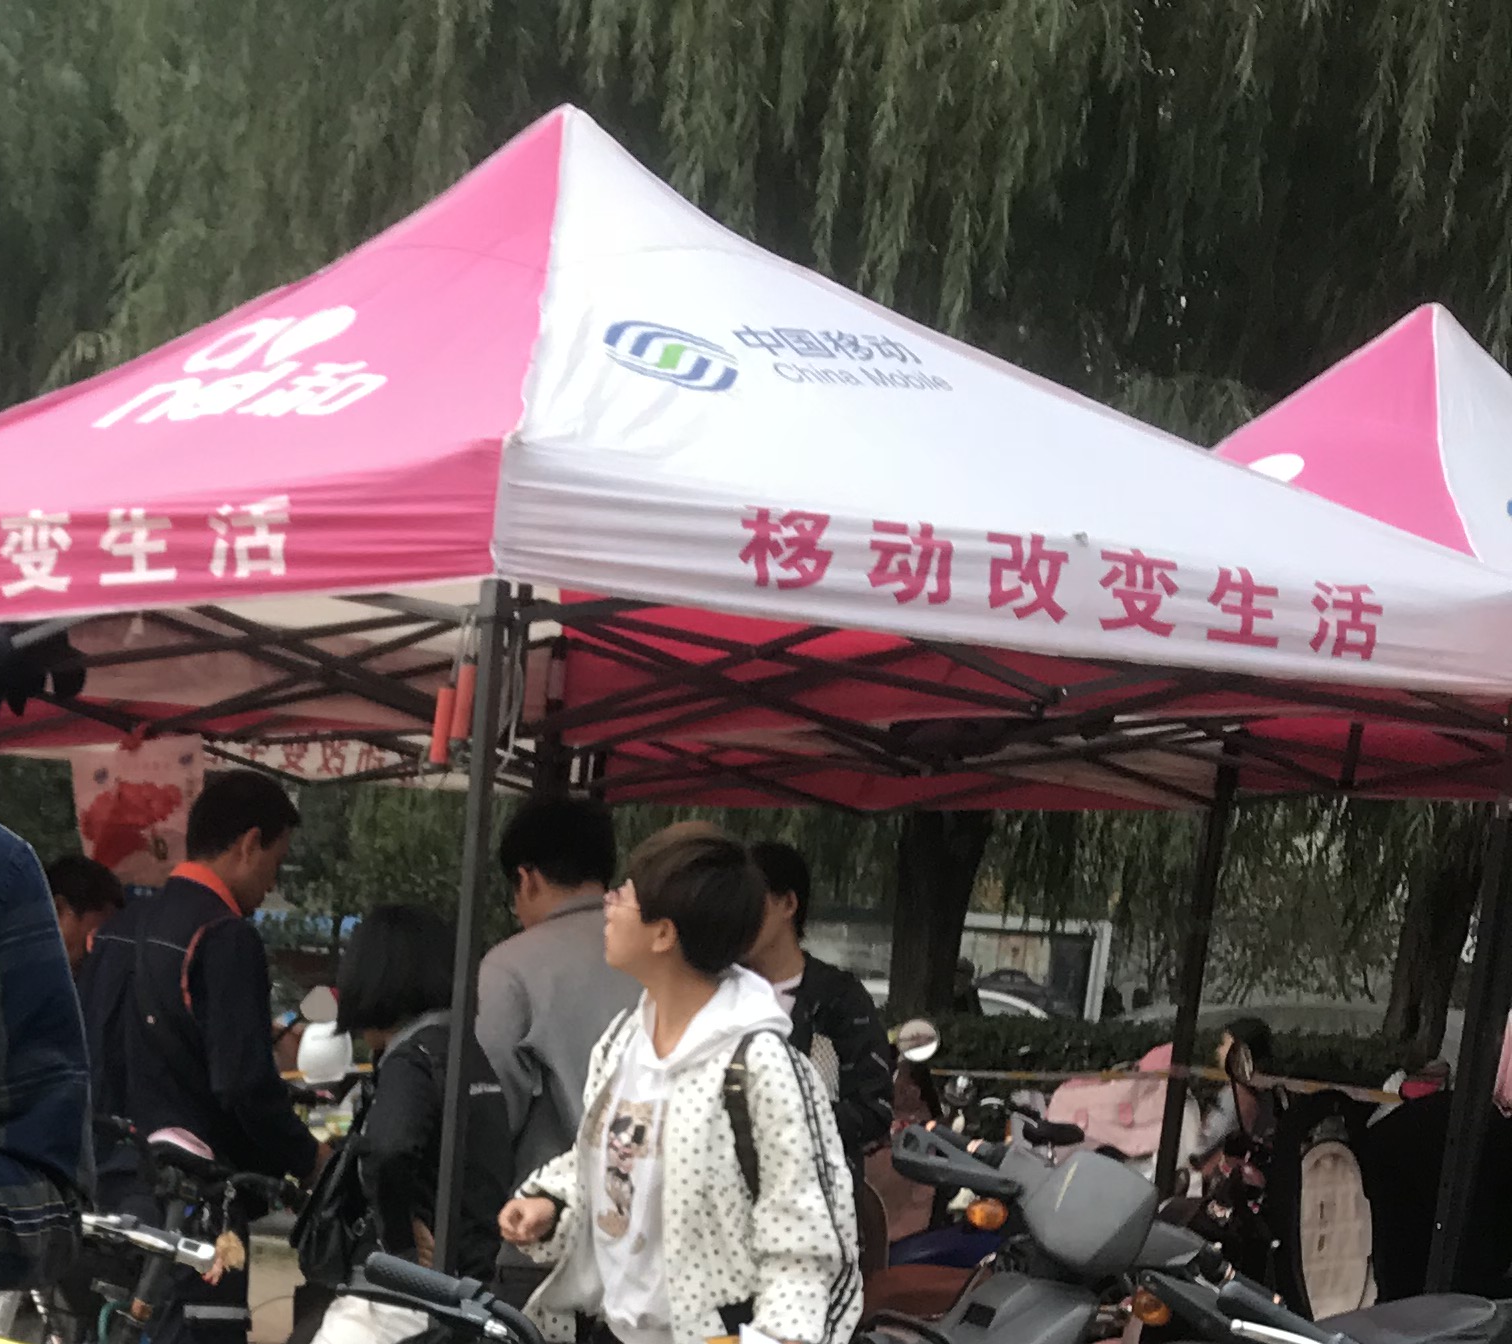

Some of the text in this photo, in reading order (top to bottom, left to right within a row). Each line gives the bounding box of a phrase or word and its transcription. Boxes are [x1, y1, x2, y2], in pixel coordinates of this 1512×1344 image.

[733, 324, 922, 365] 中国移动
[773, 362, 954, 391] China Mobile
[739, 504, 1384, 661] 移动改变生活
